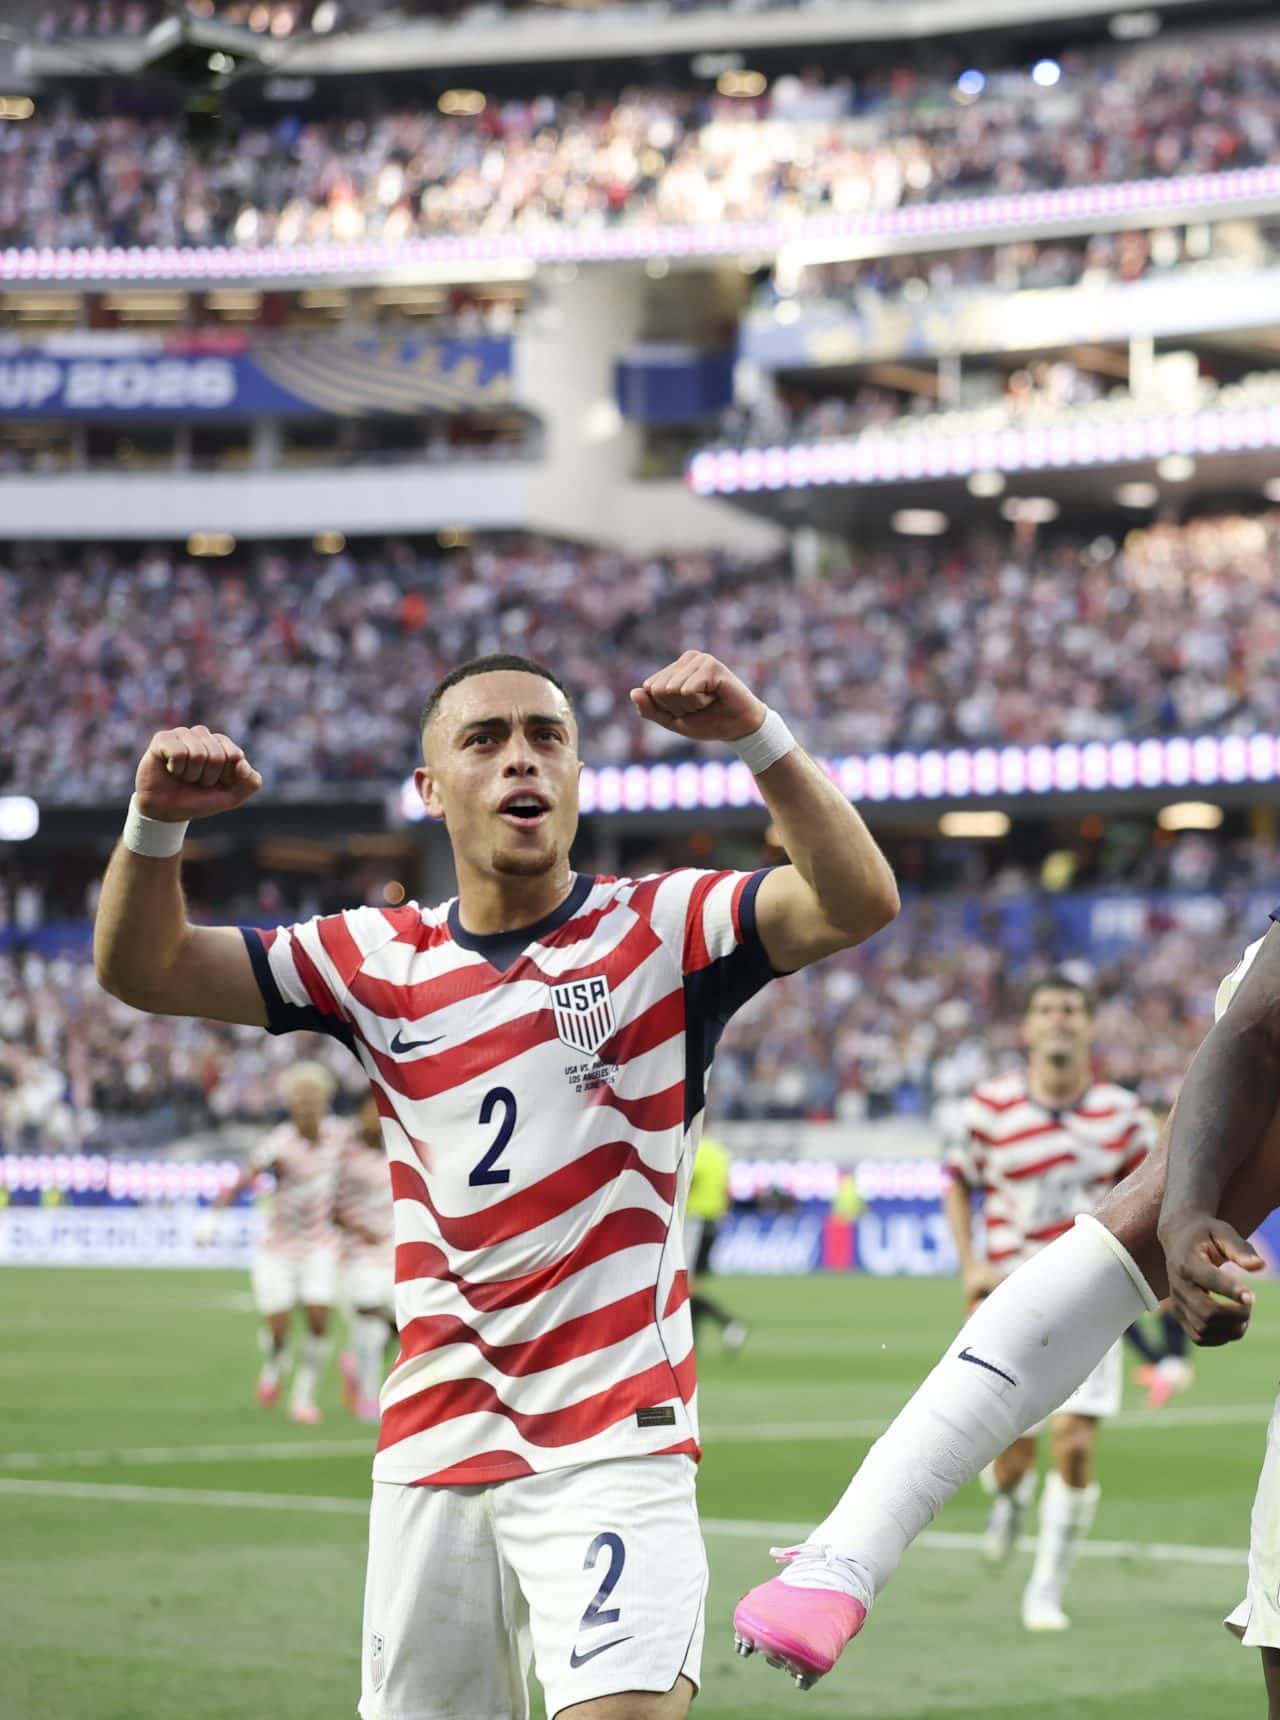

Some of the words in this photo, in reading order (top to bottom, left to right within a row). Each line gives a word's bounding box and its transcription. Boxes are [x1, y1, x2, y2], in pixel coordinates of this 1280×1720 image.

[66, 358, 237, 408] 2026
[555, 980, 605, 1011] USA
[564, 1065, 578, 1075] USA
[468, 1086, 517, 1187] 2
[579, 1531, 626, 1632] 2
